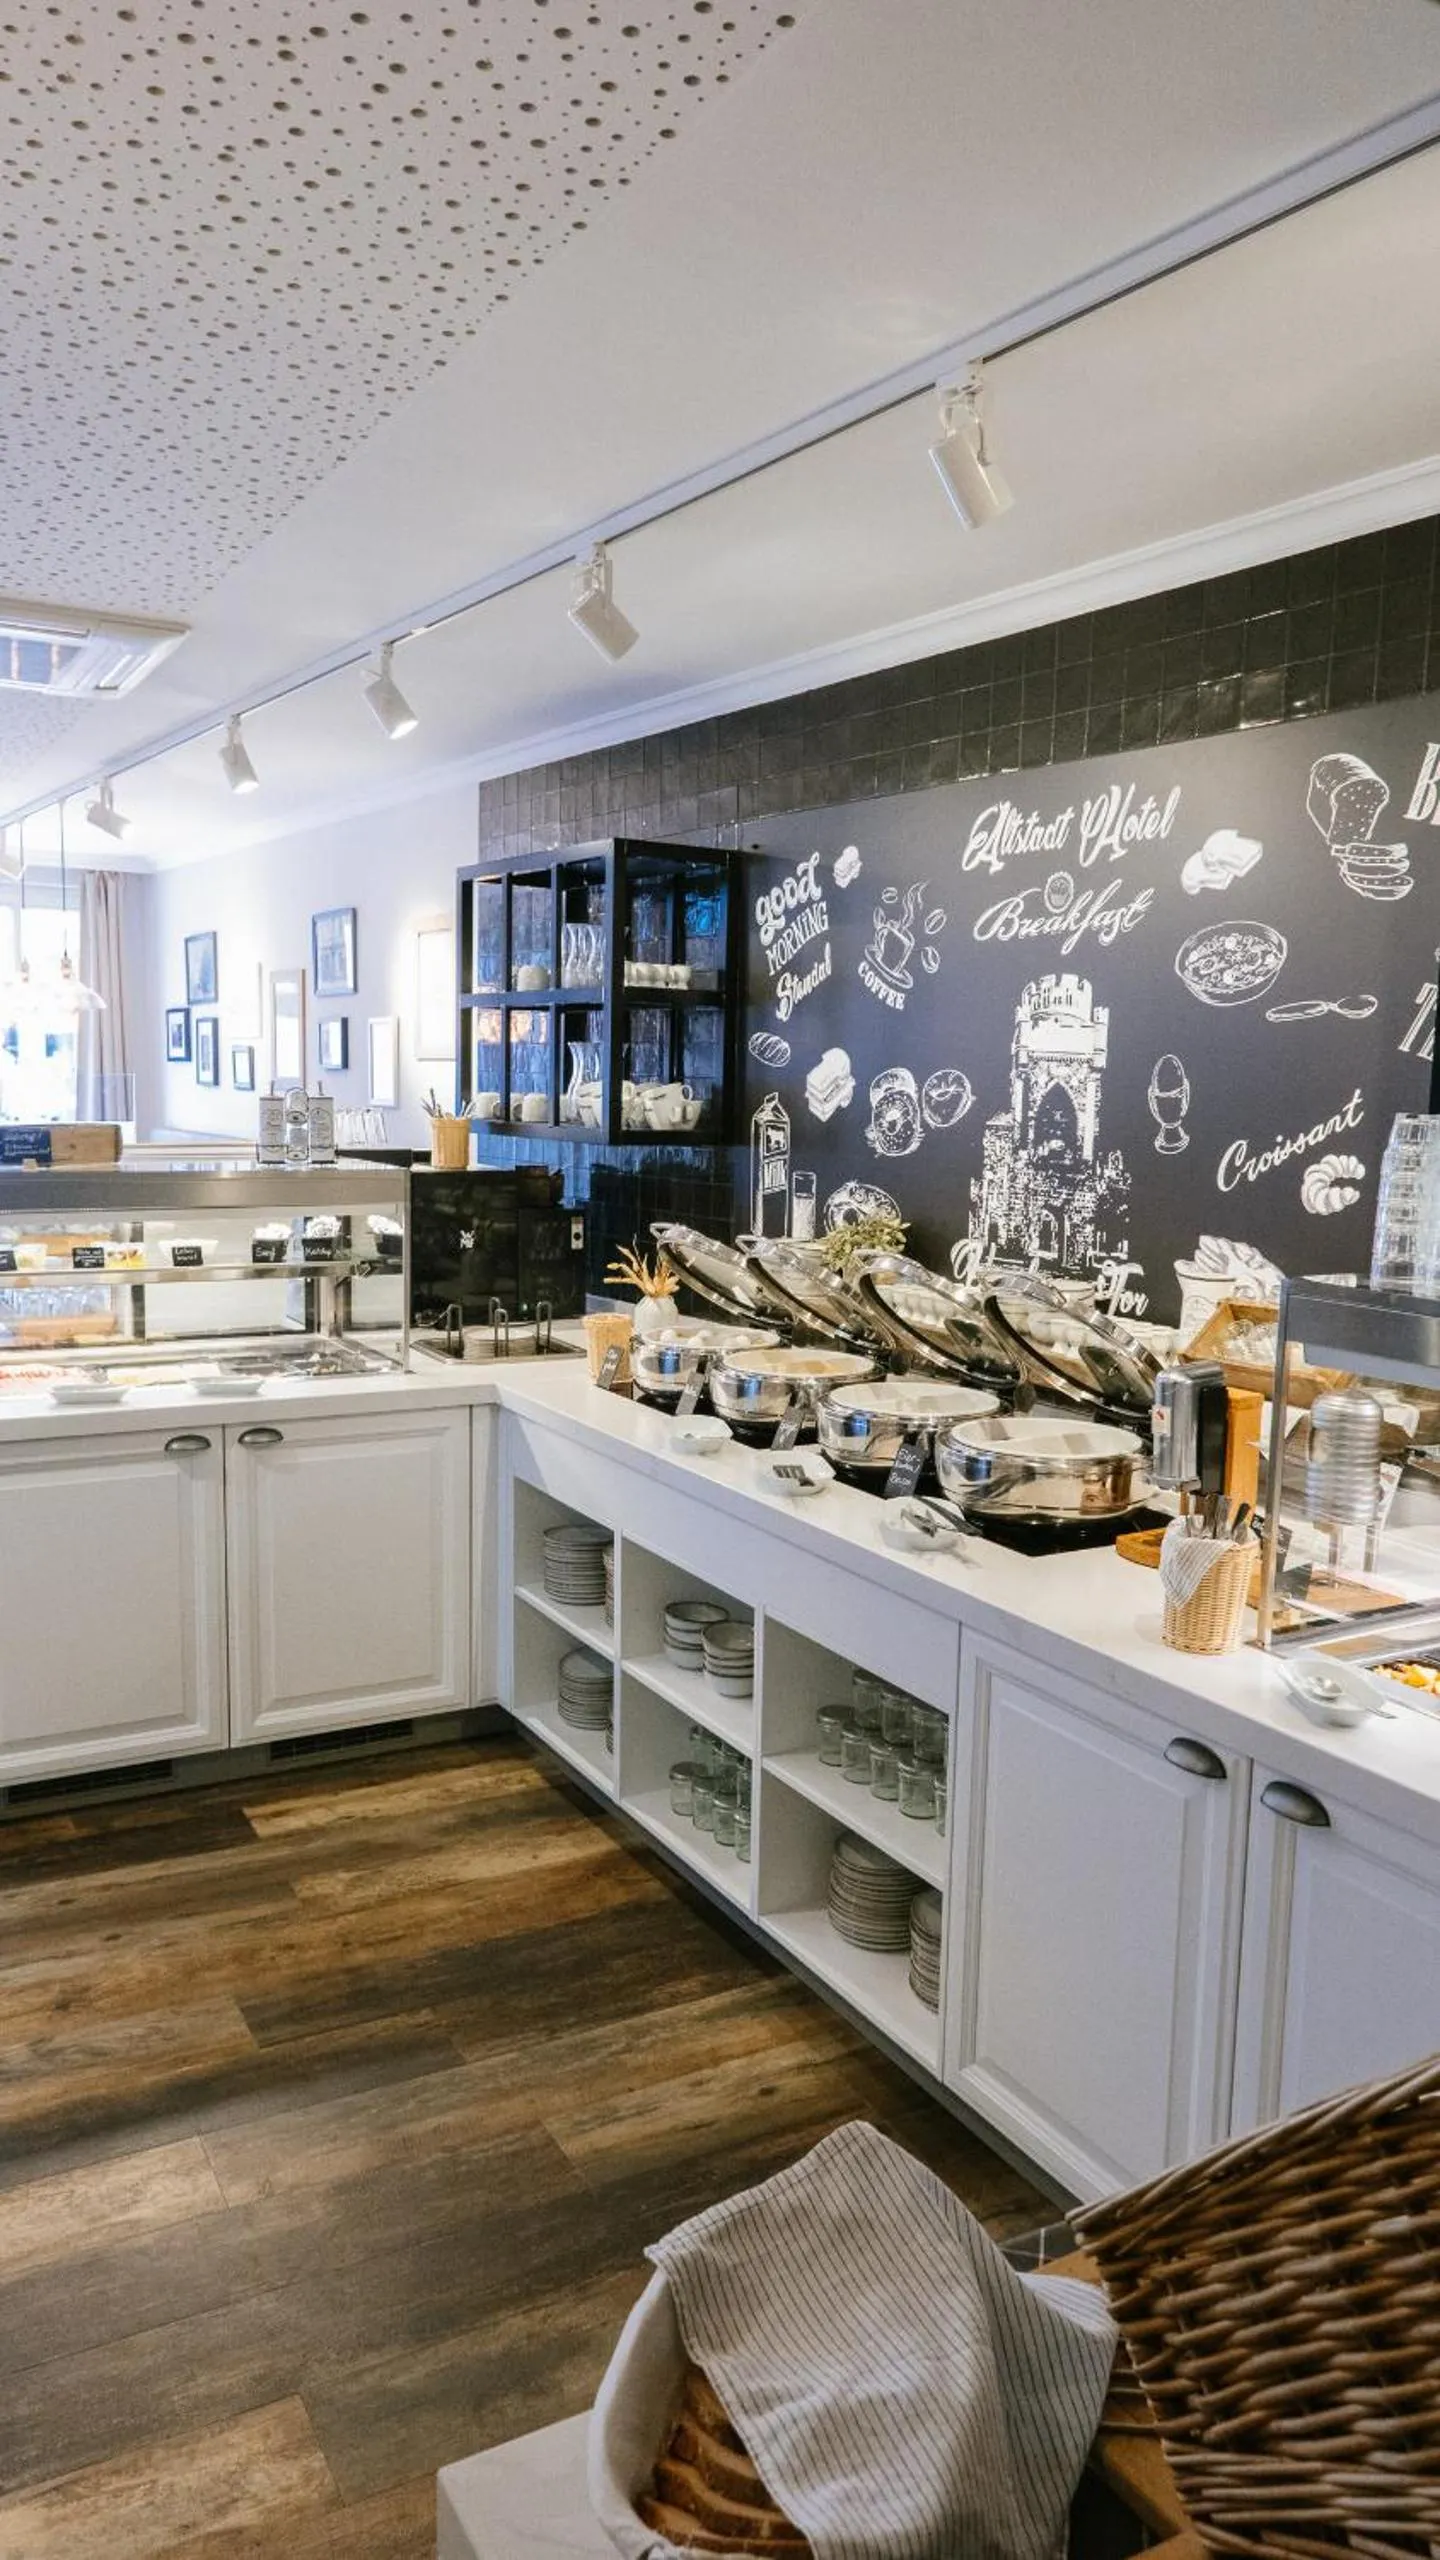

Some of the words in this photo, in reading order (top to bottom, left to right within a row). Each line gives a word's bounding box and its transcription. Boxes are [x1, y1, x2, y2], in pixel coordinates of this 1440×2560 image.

[962, 800, 1076, 875] Altstadt
[1079, 782, 1181, 867] Hotel
[755, 851, 823, 946] good
[973, 878, 1155, 954] Breakfast
[857, 960, 906, 1010] COFFEE
[1216, 1087, 1364, 1192] Croissant
